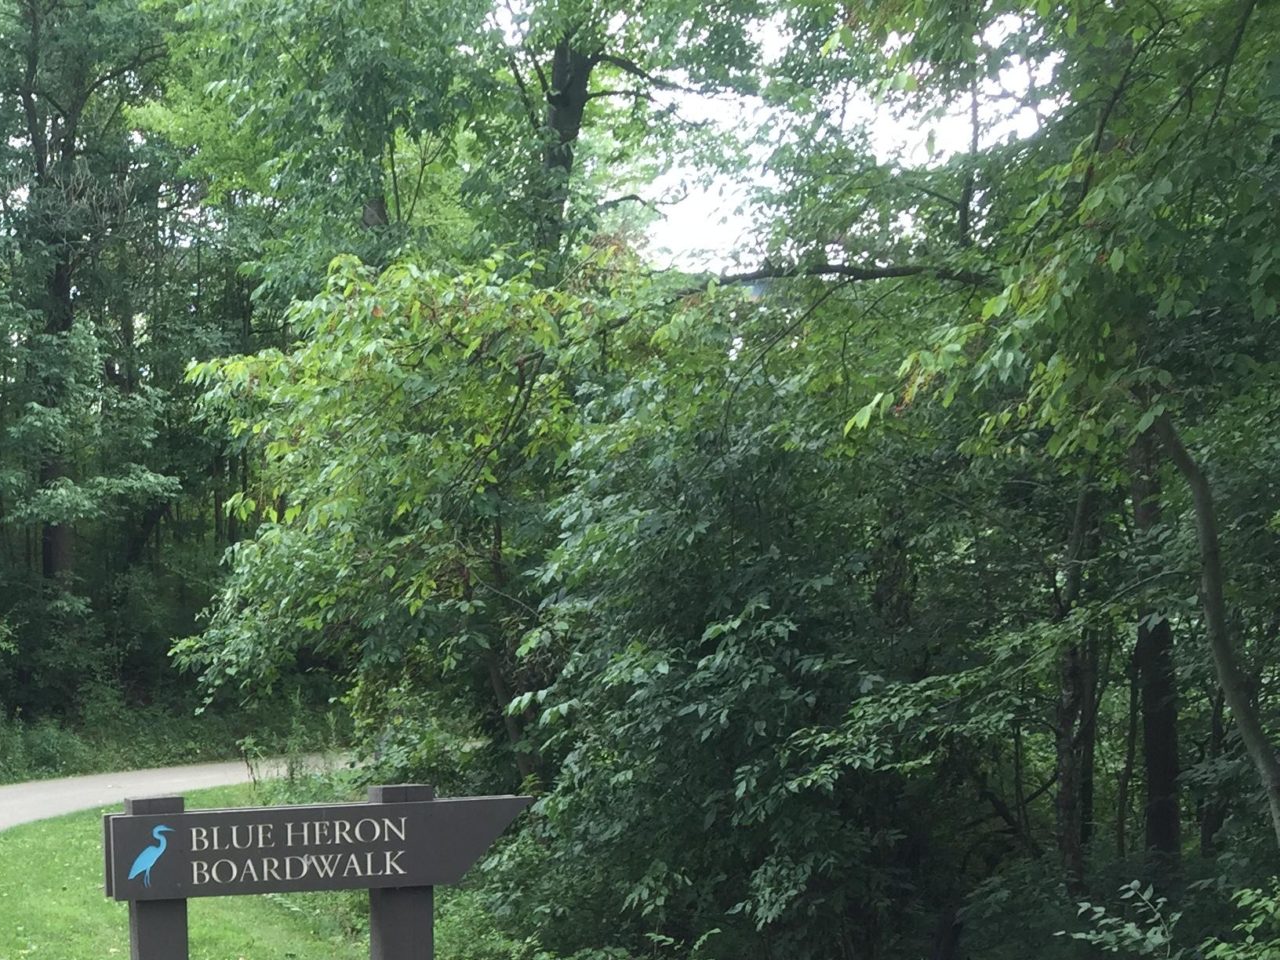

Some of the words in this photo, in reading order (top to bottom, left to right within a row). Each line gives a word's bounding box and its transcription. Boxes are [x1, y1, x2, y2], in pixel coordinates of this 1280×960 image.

[190, 823, 275, 851] BLUE
[285, 817, 408, 847] HERON
[191, 851, 408, 885] BOARDWALK
